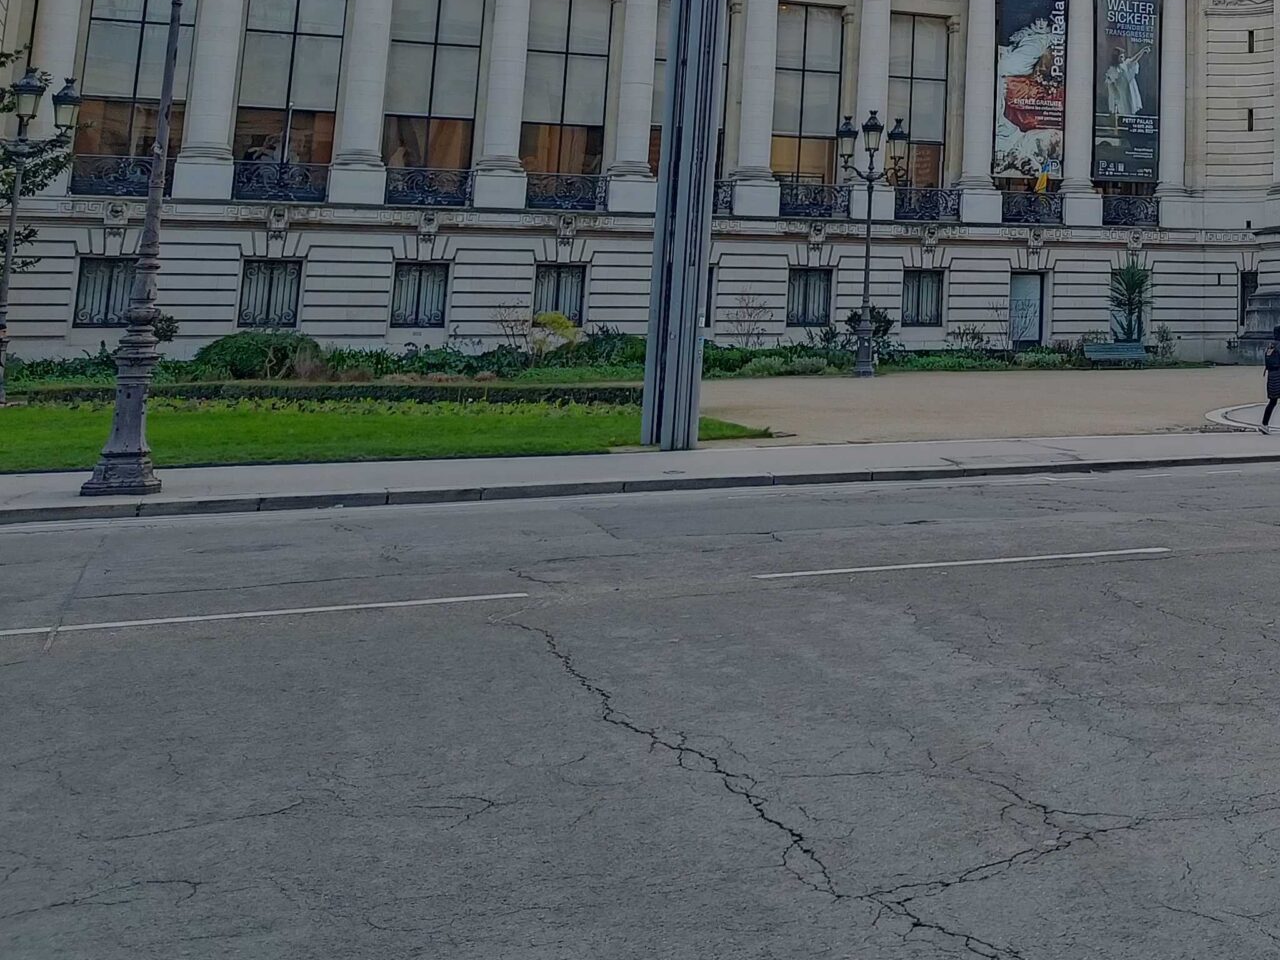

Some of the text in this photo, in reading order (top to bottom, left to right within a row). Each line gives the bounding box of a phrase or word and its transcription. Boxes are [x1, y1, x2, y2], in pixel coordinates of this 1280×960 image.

[1107, 10, 1157, 26] SICKERT
[1105, 28, 1154, 38] TRANSGRESSER
[1116, 23, 1144, 32] PEINDRE
[1051, 38, 1064, 76] Petit
